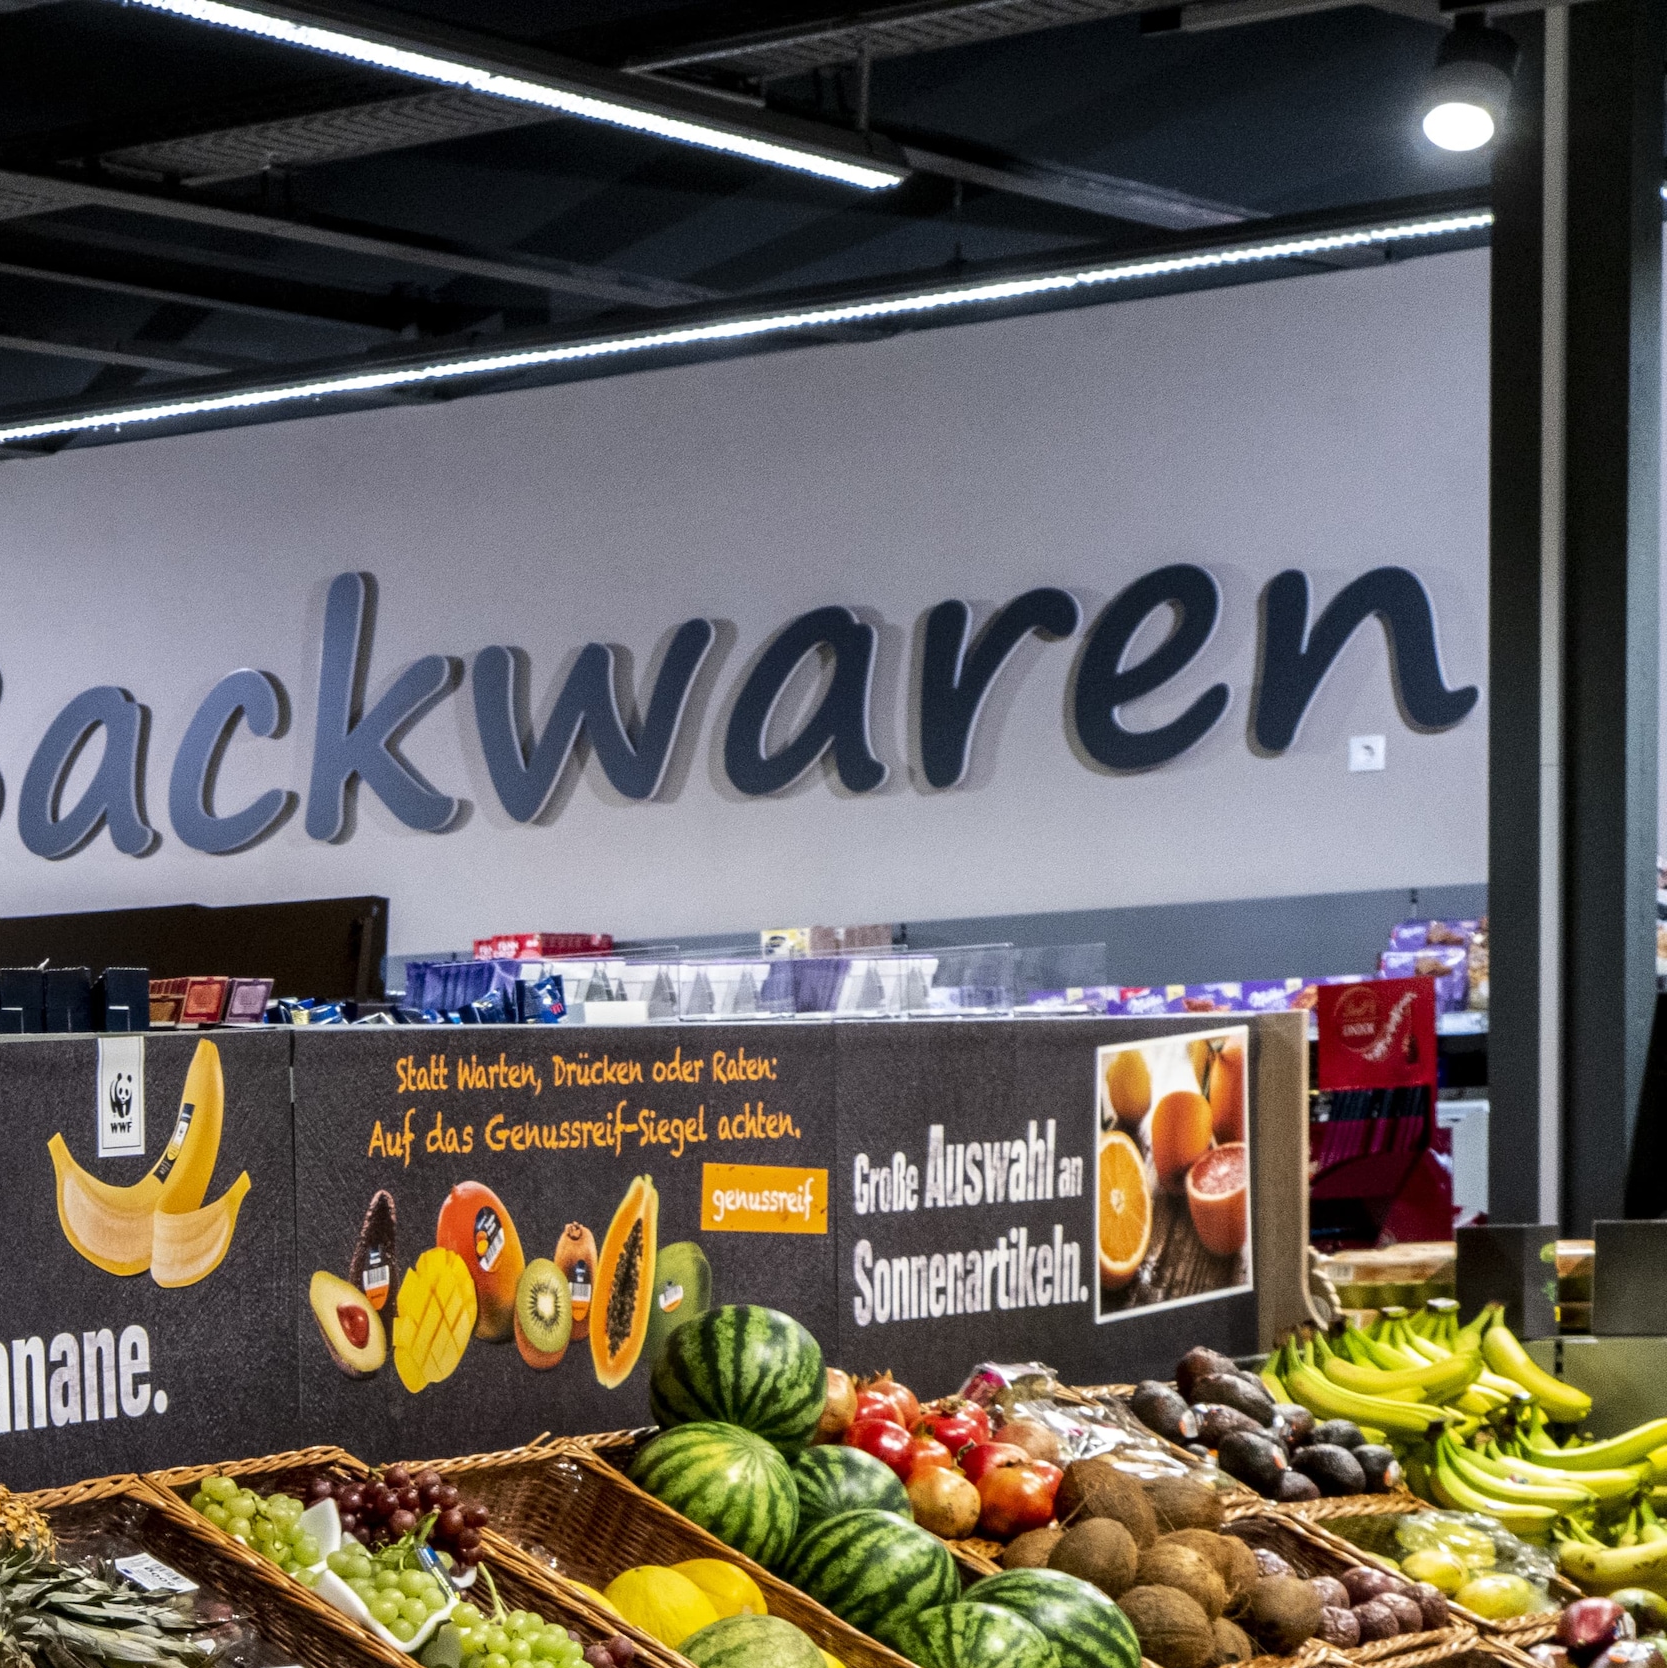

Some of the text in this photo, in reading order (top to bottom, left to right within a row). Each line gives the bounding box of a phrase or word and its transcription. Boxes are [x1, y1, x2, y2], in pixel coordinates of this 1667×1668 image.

[395, 1048, 778, 1097] Statt Warten, Drücken oder Raten:
[109, 1121, 134, 1134] WWF
[366, 1108, 802, 1162] Auf das Genussreif-Siegel achten.
[852, 1117, 1084, 1218] Große Auswahl an
[710, 1182, 816, 1220] genussreif
[852, 1225, 1091, 1326] Sonnenartikeln.
